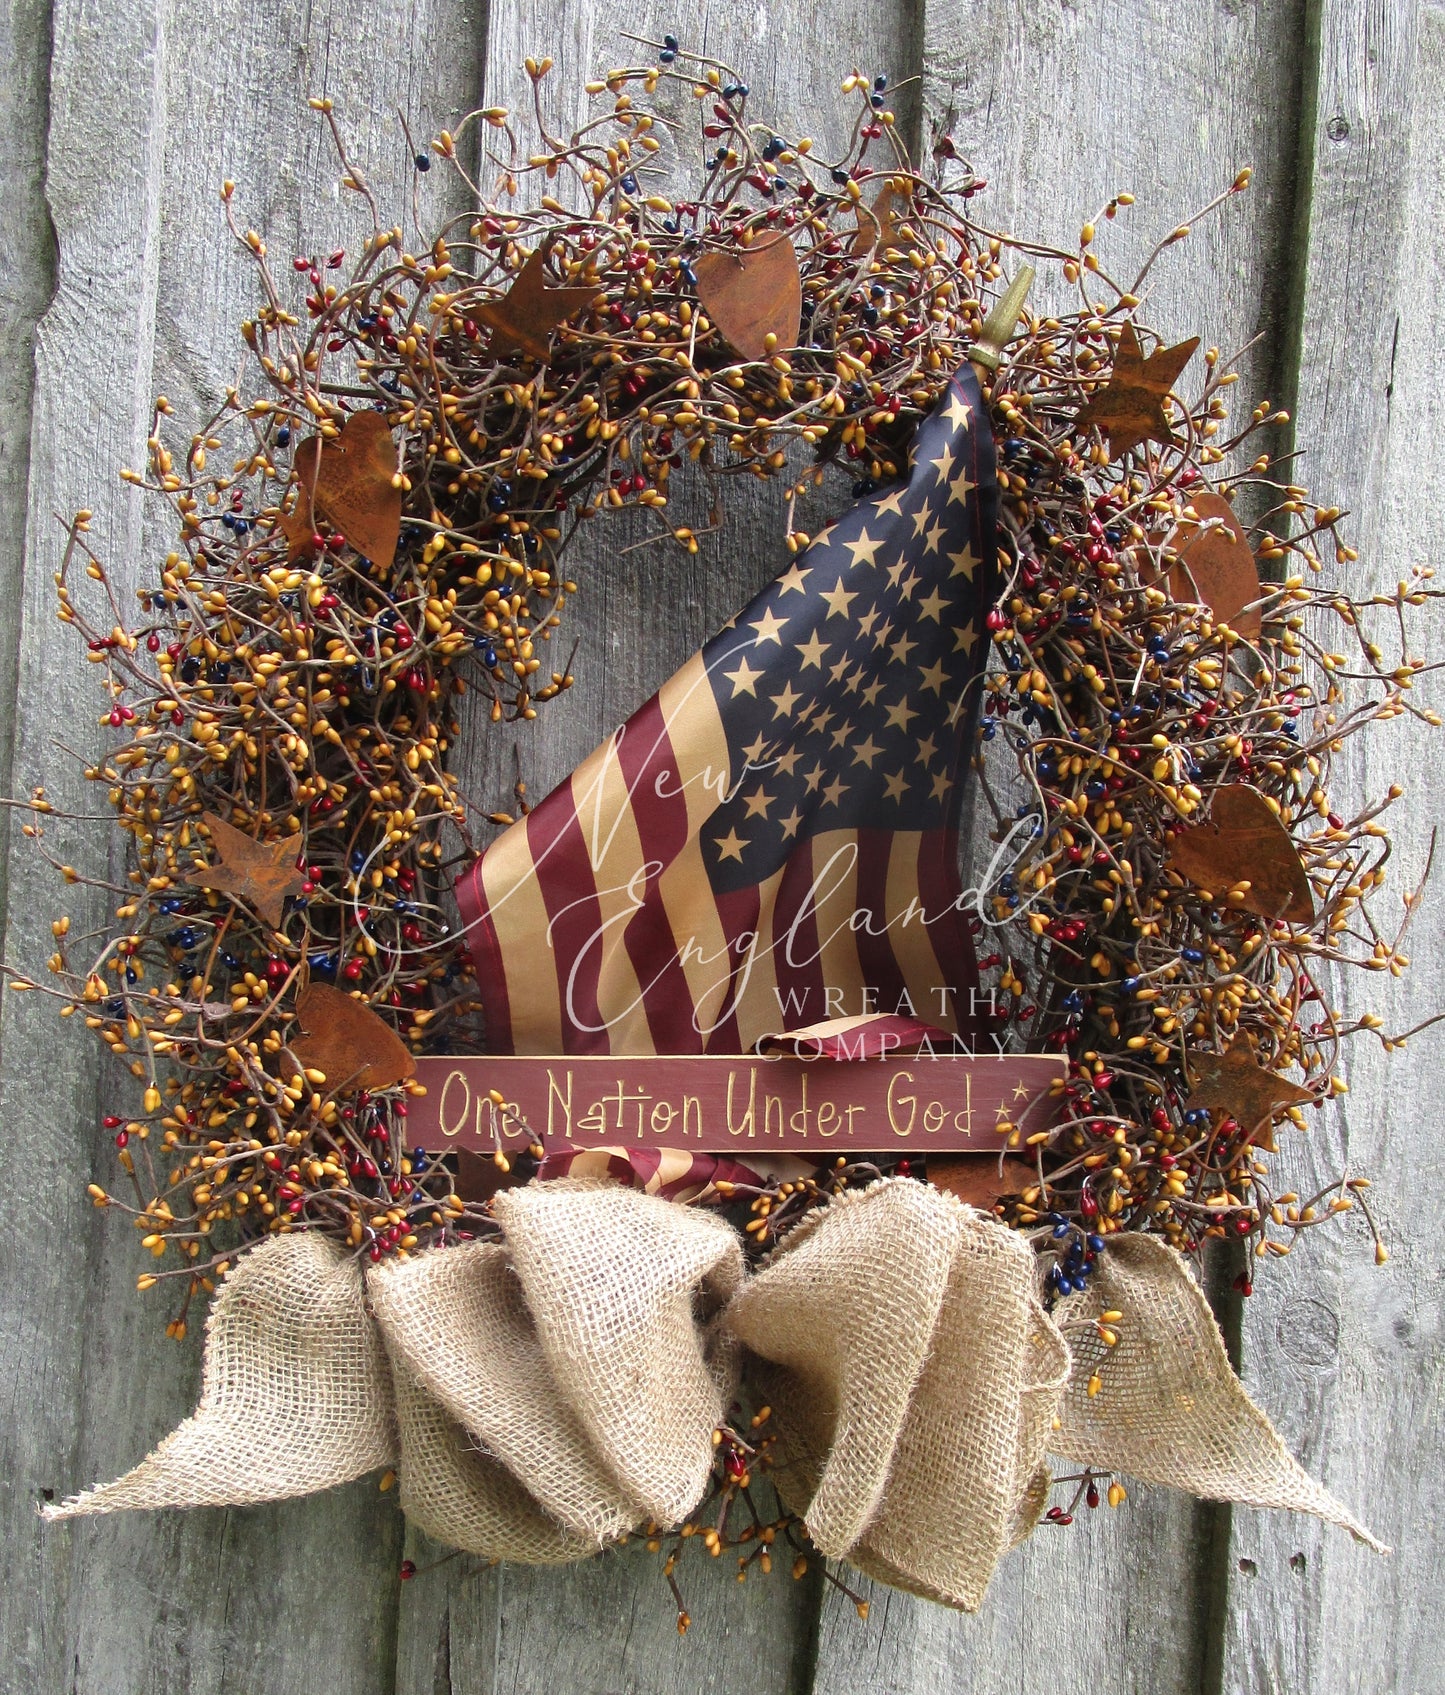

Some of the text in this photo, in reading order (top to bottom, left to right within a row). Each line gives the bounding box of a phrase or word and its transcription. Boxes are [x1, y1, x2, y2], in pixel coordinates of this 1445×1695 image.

[439, 1067, 976, 1138] One Nation Under God
